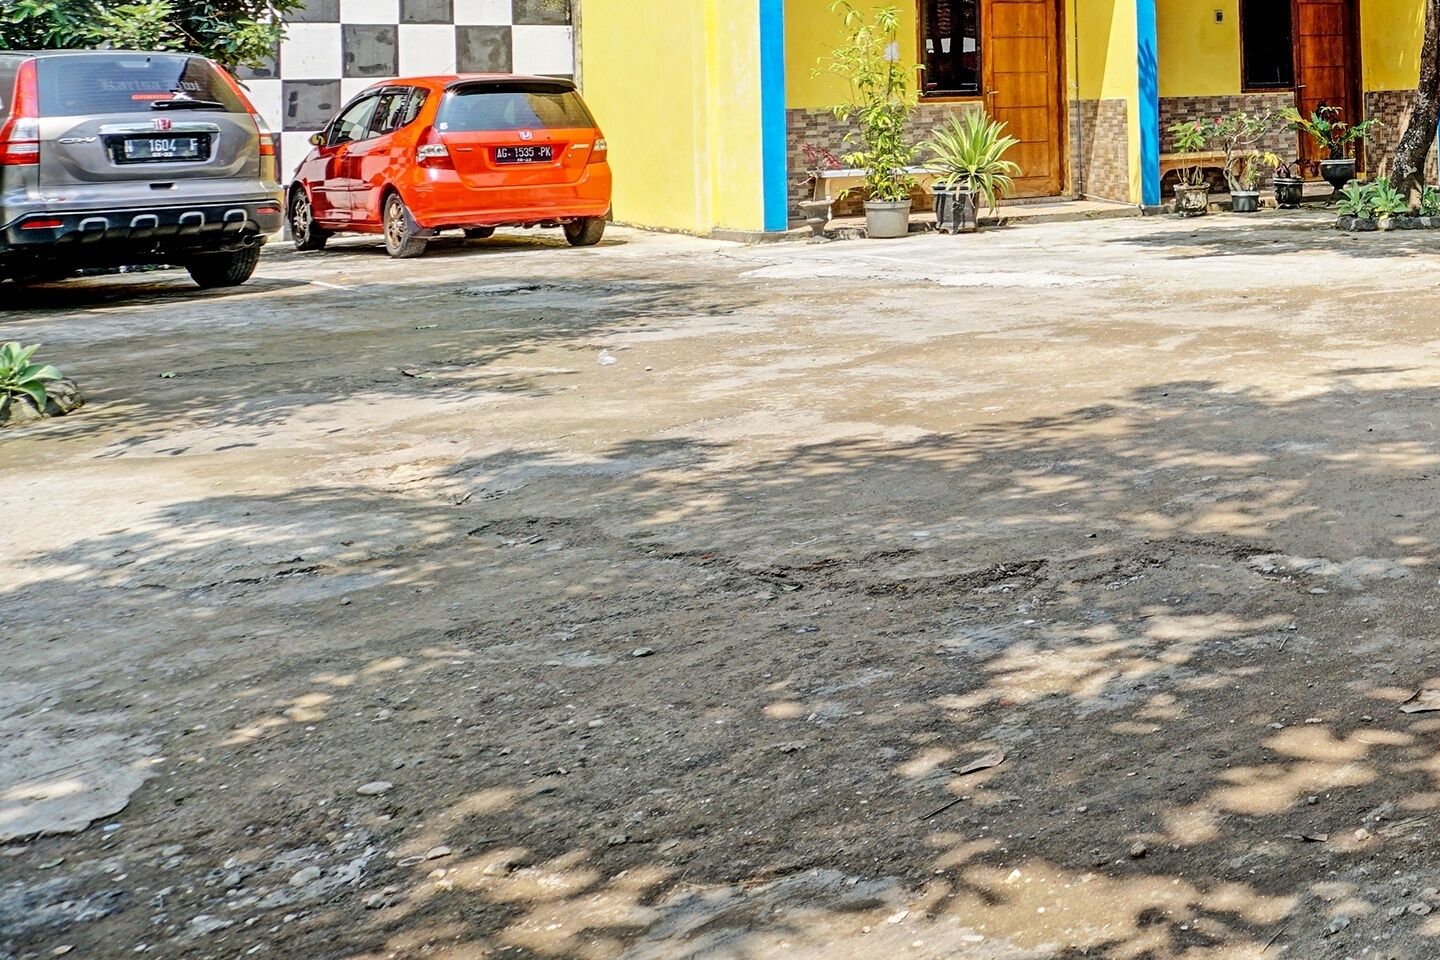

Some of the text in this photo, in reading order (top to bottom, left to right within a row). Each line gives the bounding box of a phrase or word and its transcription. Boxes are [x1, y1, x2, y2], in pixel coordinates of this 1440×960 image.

[124, 137, 198, 153] N 1604 F
[515, 147, 534, 157] 1535
[540, 147, 551, 156] PK
